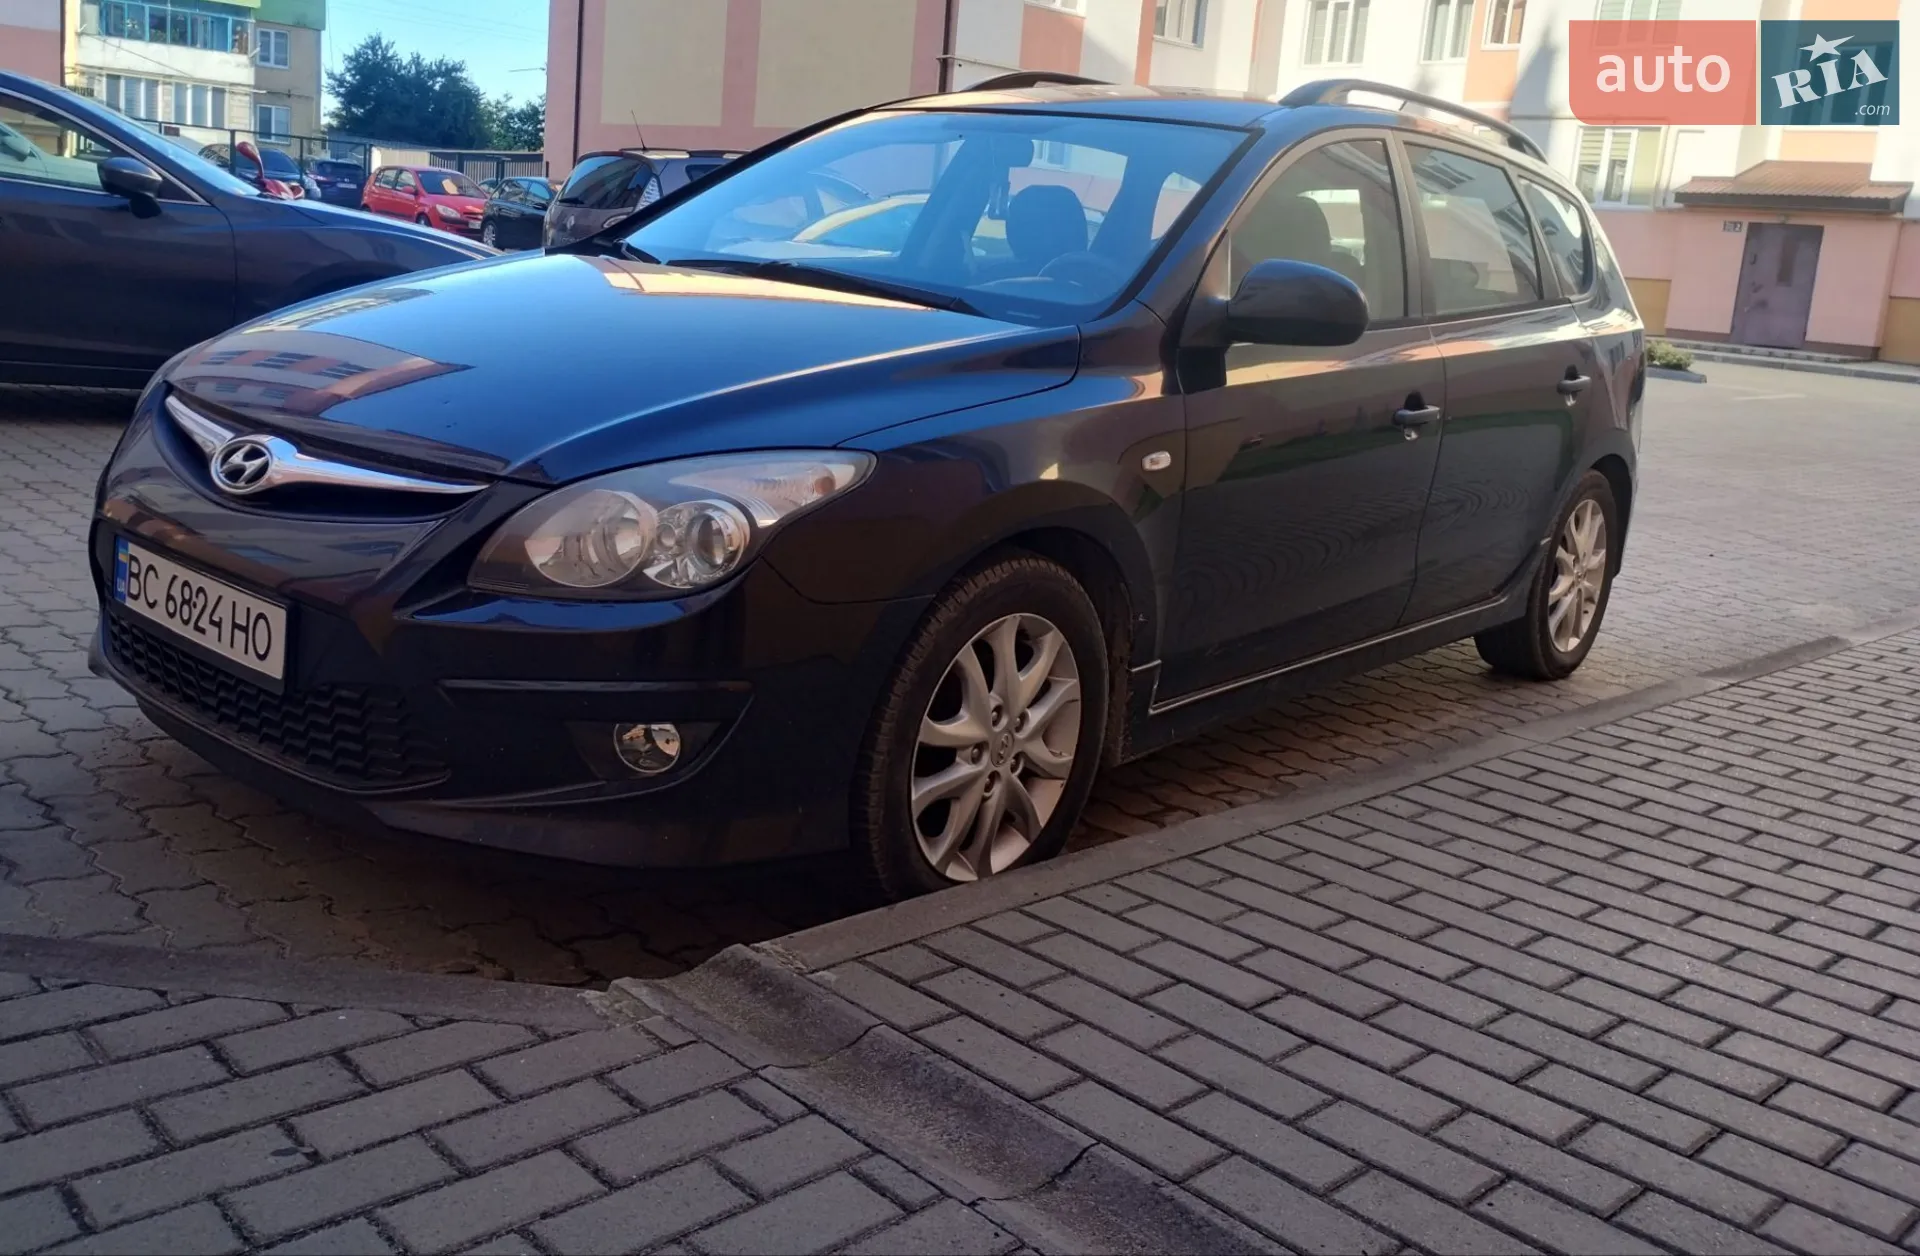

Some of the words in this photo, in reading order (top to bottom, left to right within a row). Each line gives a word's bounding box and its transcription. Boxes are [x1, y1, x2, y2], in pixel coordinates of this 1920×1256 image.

[127, 554, 160, 610] BC
[165, 574, 224, 644] 6824
[229, 600, 272, 662] HO
